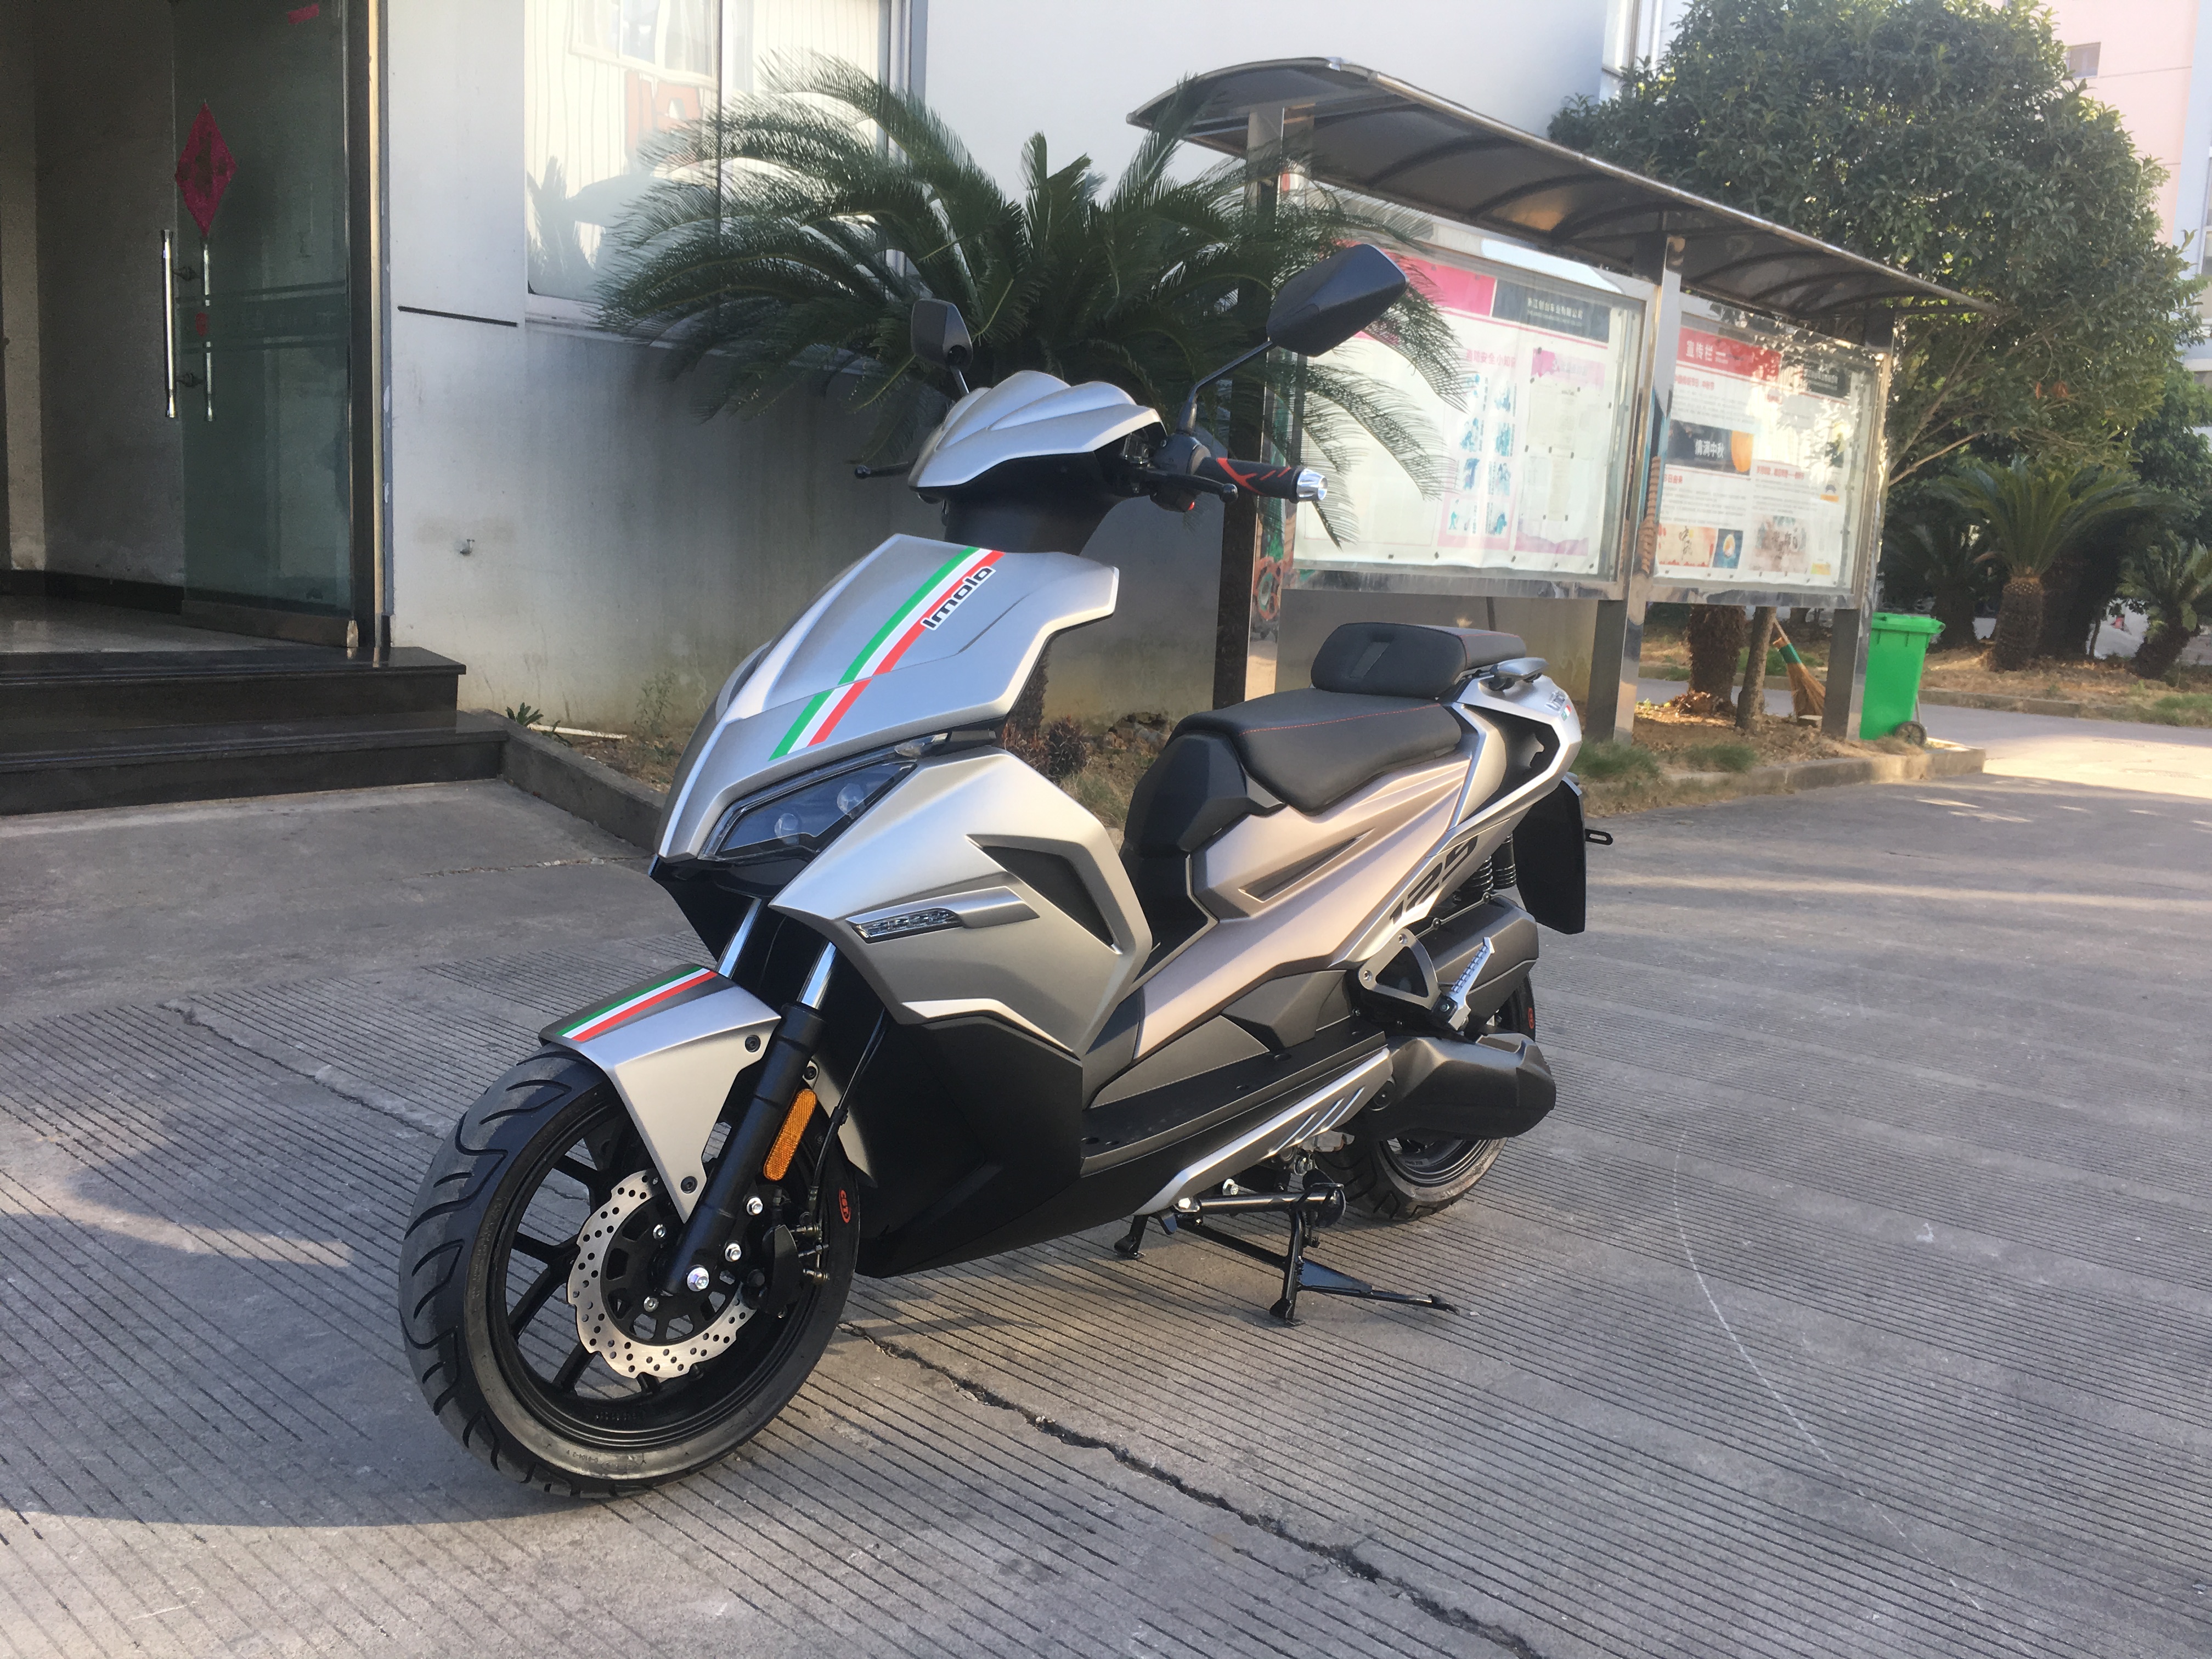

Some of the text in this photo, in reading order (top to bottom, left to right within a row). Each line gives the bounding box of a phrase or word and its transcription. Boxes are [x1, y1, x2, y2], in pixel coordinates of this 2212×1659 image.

[1695, 439, 1725, 459] 情满中秋
[922, 567, 993, 629] Imola
[1390, 834, 1479, 925] 125
